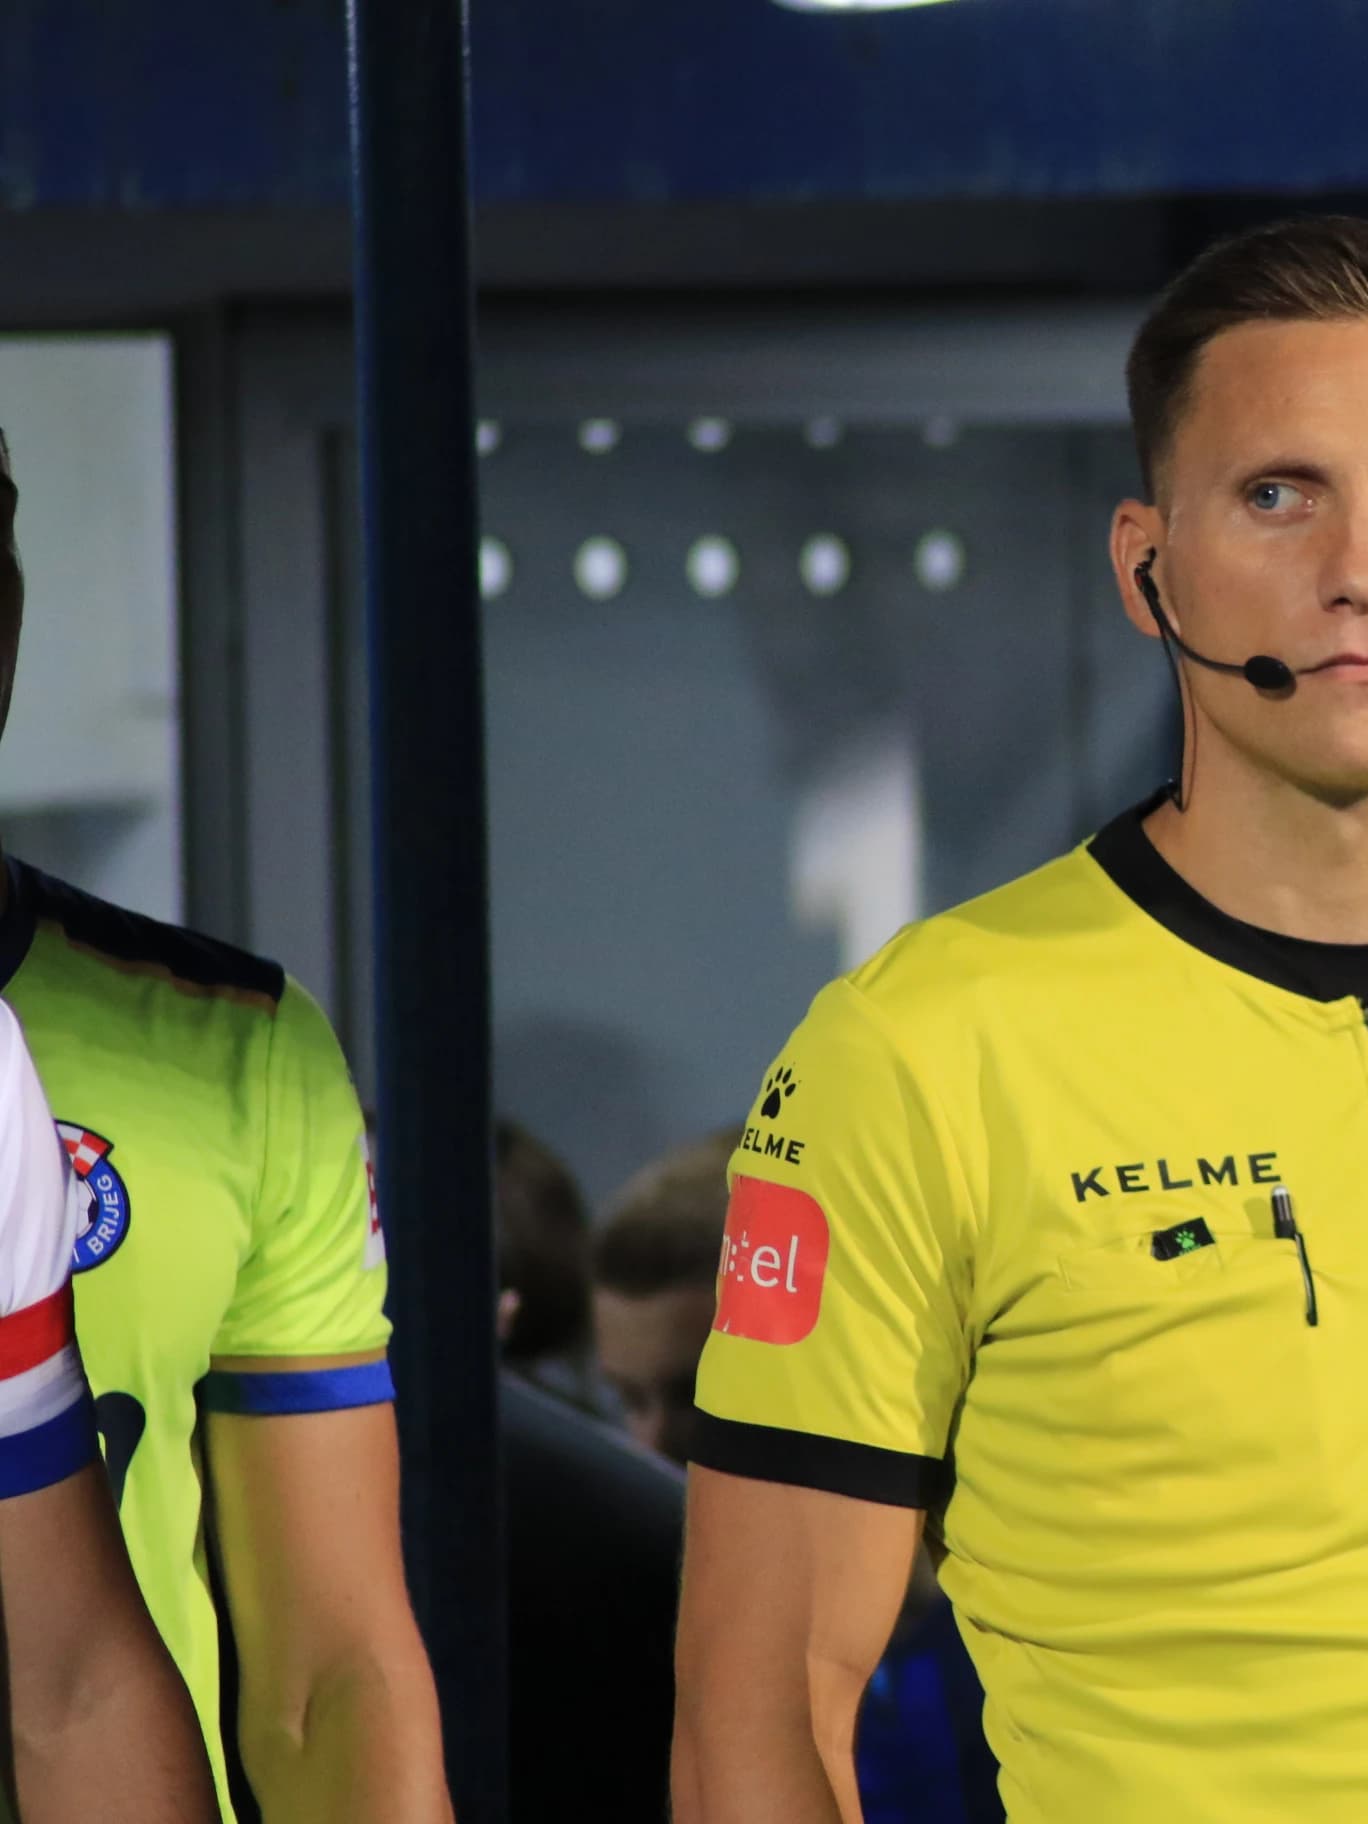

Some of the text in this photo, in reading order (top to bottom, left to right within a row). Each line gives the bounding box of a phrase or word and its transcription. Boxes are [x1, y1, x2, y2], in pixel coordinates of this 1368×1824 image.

[742, 1128, 805, 1166] ELME
[1071, 1152, 1281, 1203] KELME
[86, 1174, 120, 1256] BRIJEG
